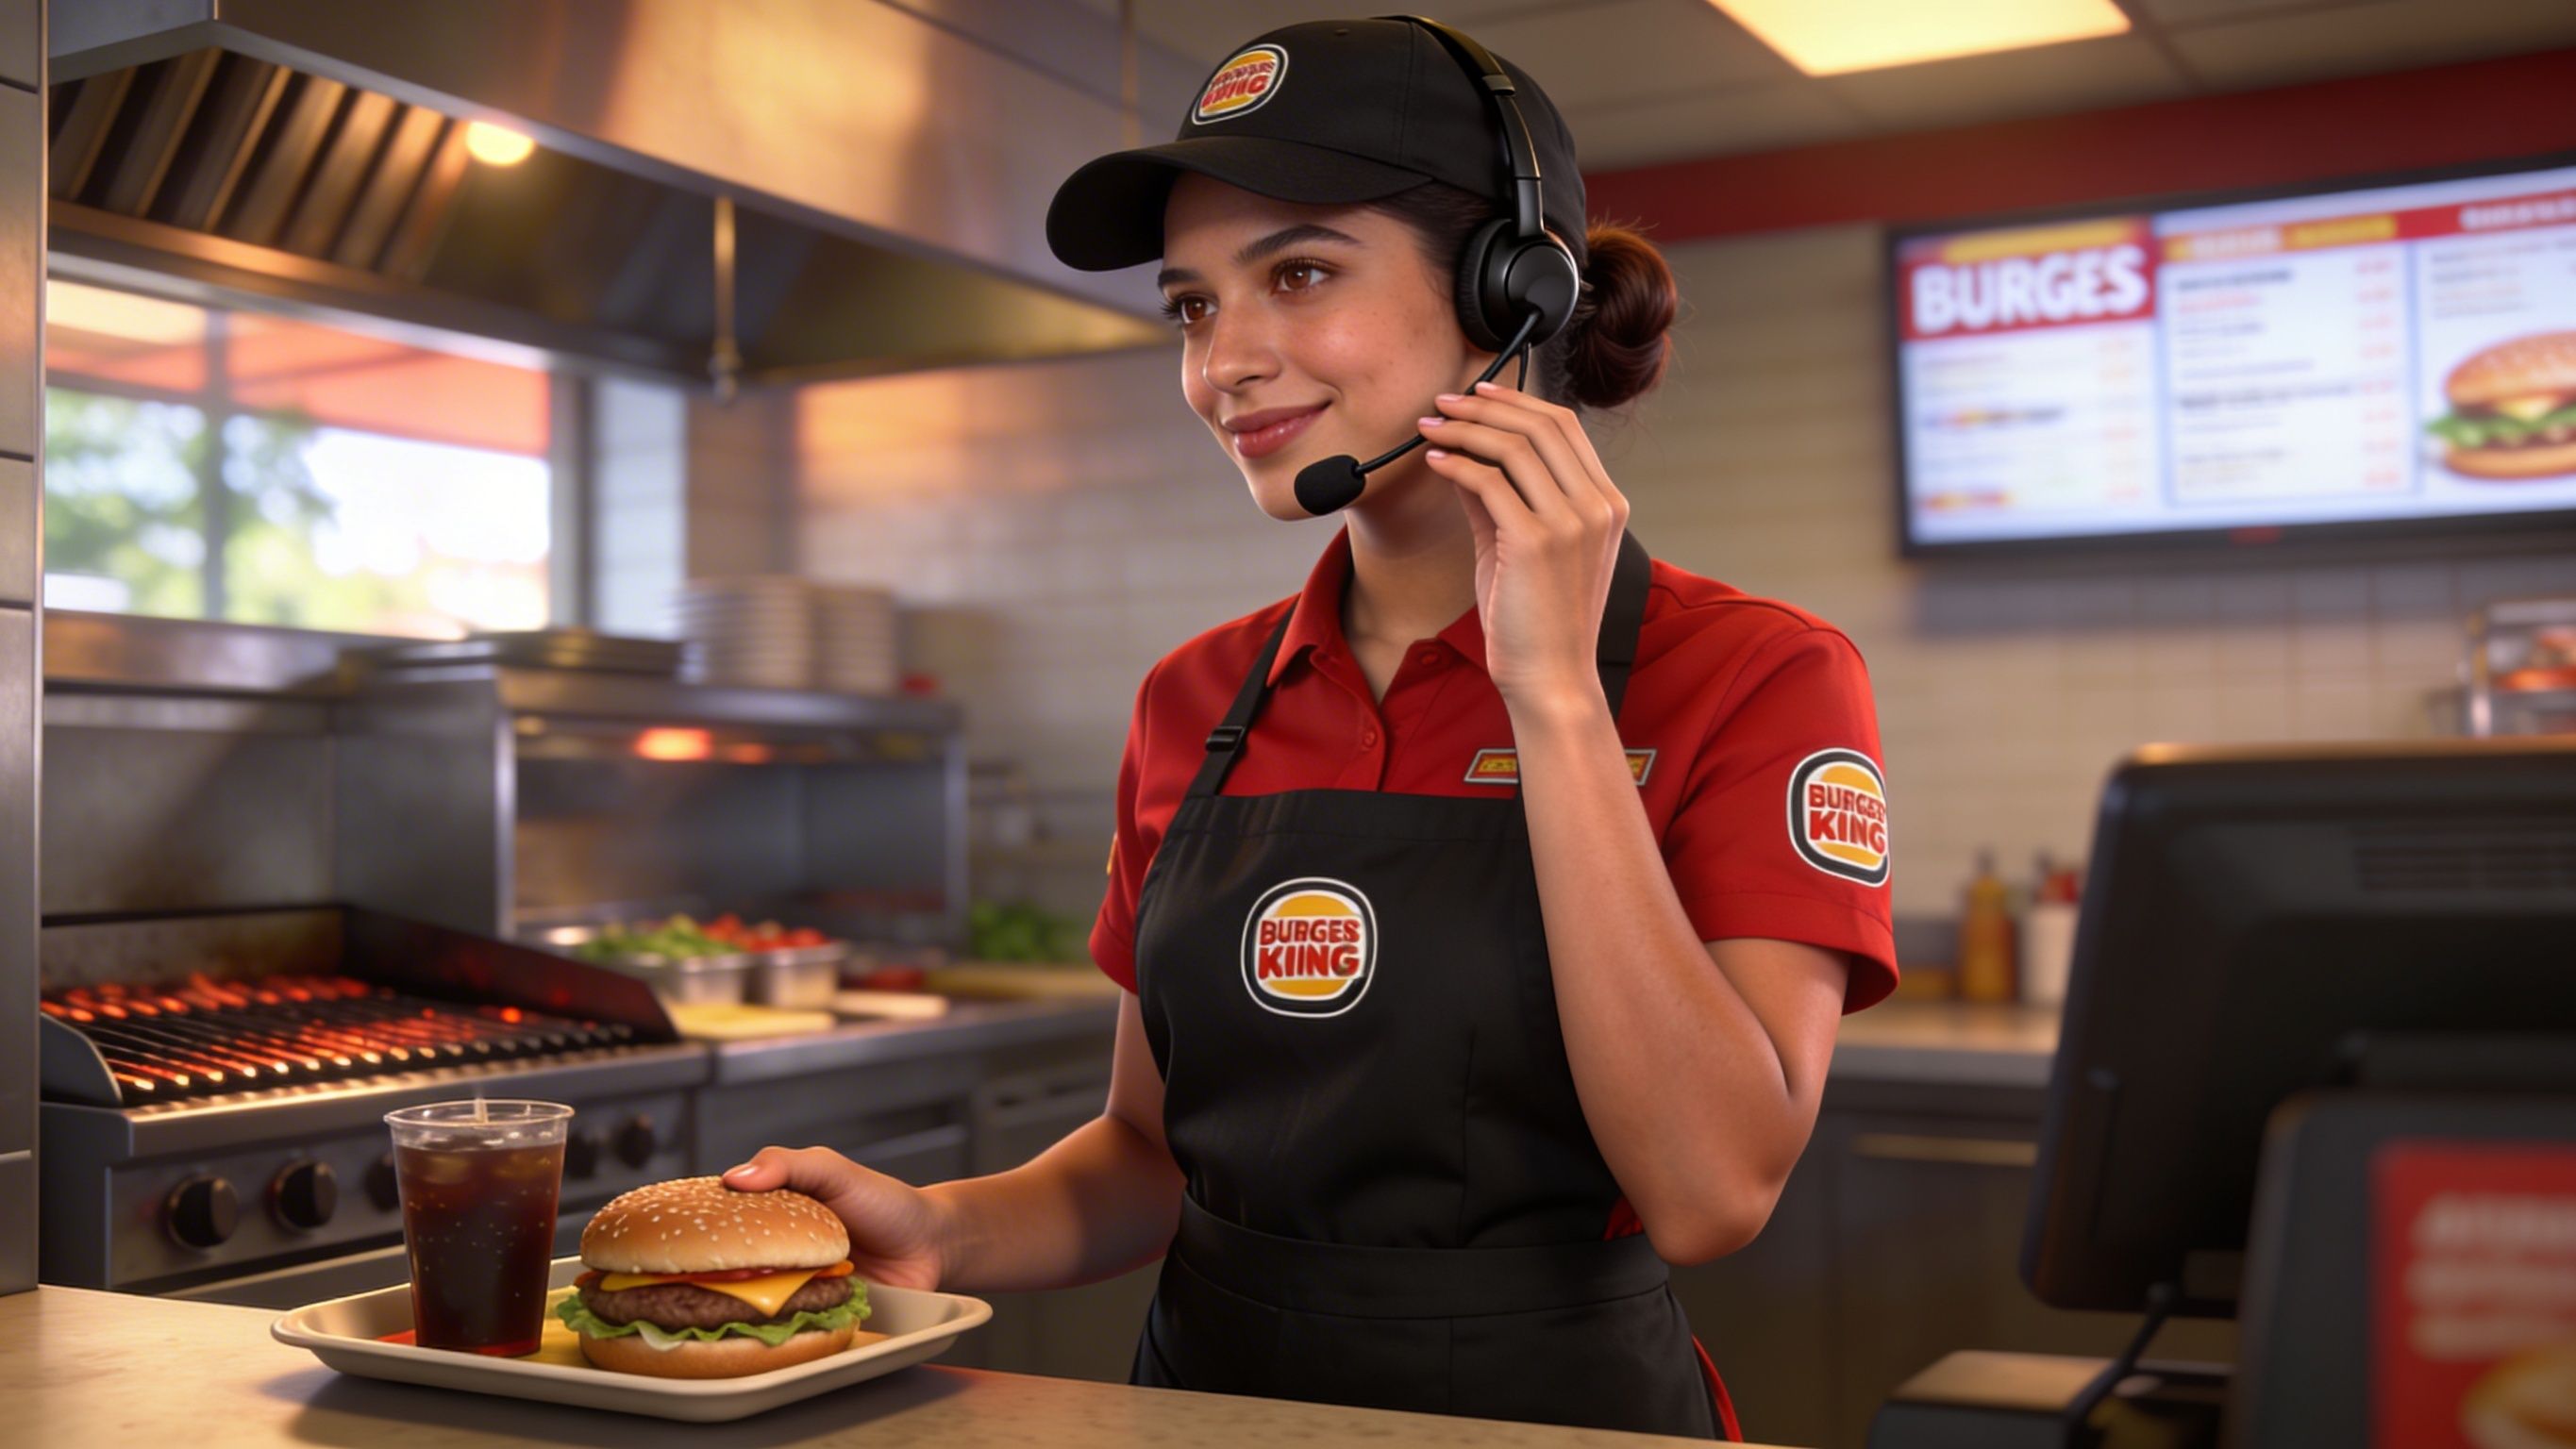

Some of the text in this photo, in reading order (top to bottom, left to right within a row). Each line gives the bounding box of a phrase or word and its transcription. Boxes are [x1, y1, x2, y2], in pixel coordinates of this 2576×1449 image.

[1912, 244, 2149, 335] BURGES
[1808, 809, 1886, 855] KING
[1260, 918, 1361, 946] BURGES
[1258, 943, 1361, 980] KIING
